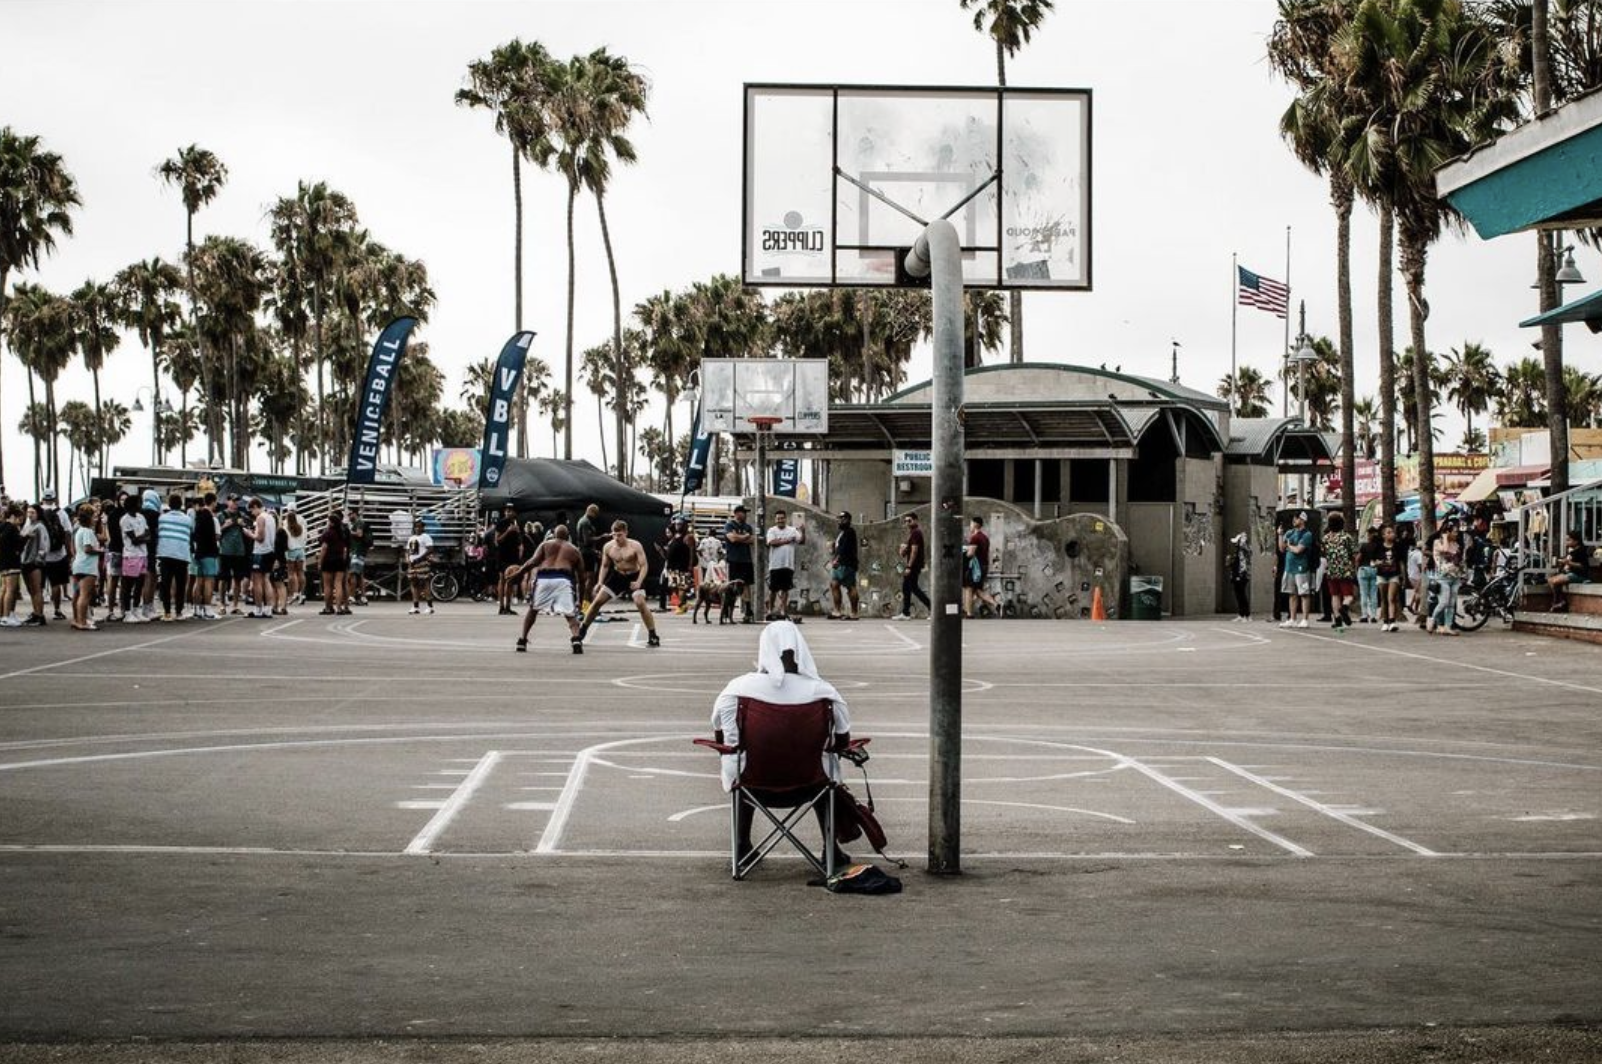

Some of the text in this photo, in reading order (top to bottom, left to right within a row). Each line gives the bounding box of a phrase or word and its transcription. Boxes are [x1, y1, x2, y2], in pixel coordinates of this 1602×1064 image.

[356, 338, 400, 471] VENICEBALL
[797, 411, 821, 420] CLIPPERS
[903, 453, 931, 461] PUBLIC
